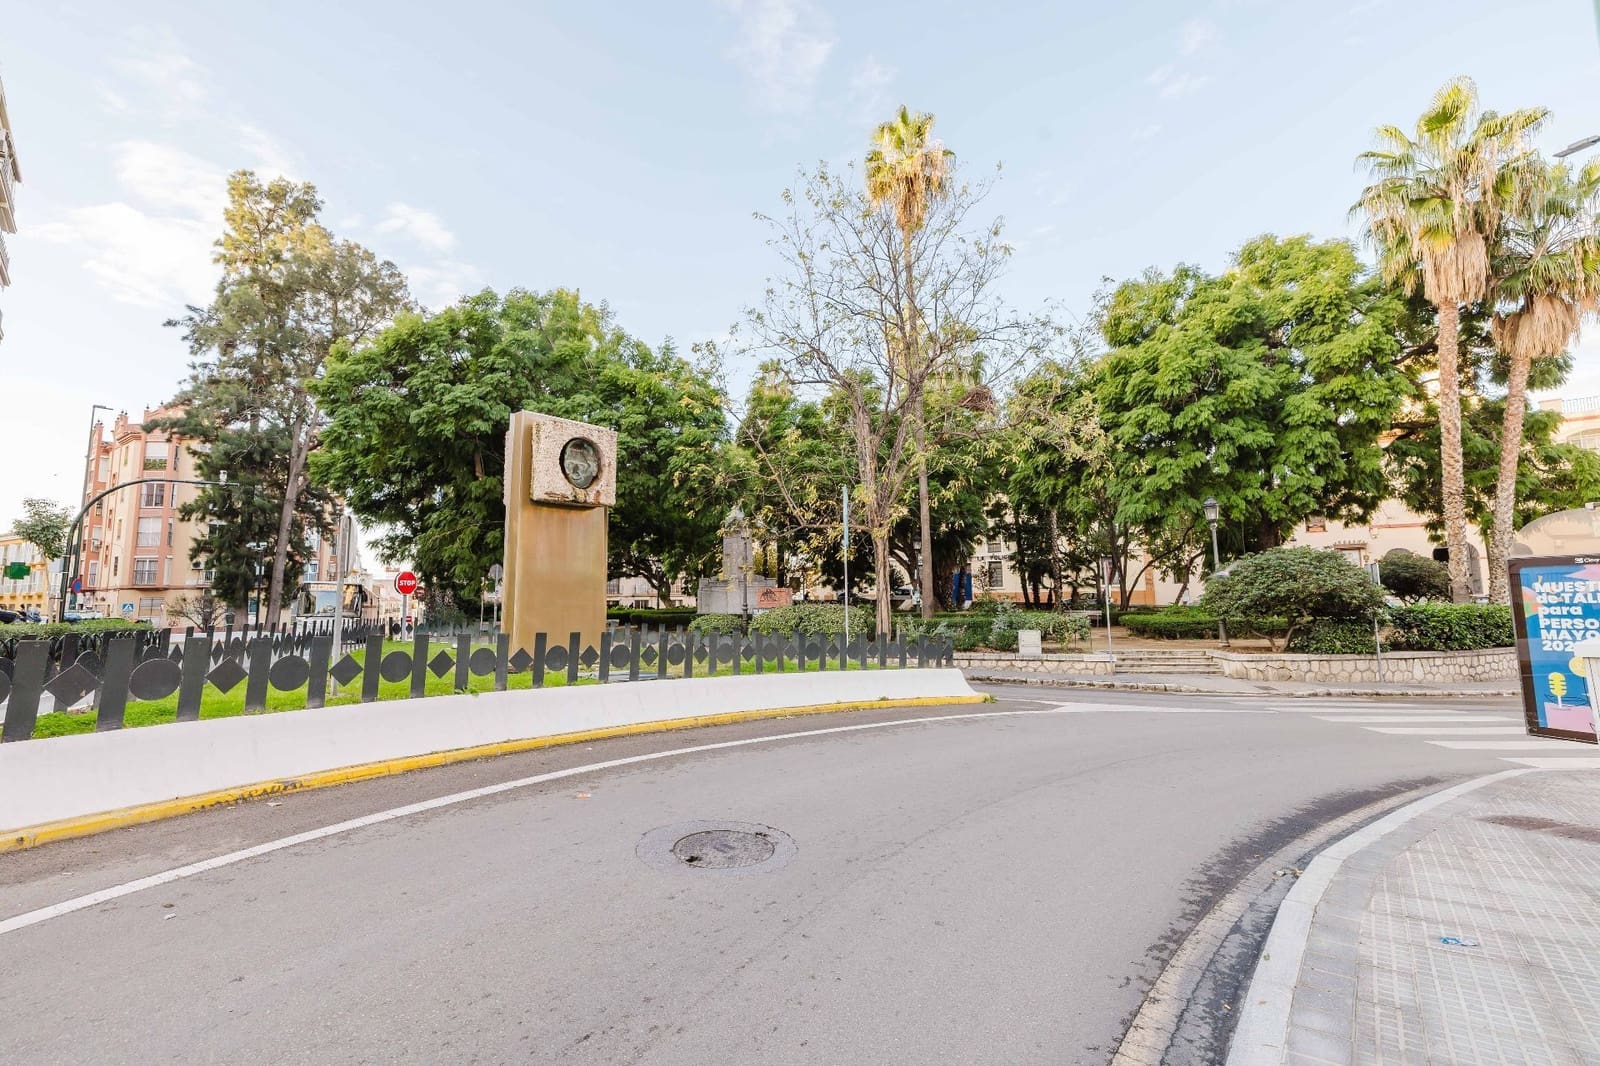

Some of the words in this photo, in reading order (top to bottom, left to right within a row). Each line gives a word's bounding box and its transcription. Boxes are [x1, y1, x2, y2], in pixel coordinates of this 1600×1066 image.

[1533, 581, 1600, 593] MUEST
[1536, 592, 1562, 604] de
[1561, 593, 1600, 604] TAL
[1538, 606, 1583, 619] para
[1539, 618, 1600, 630] PERSO
[1542, 640, 1577, 652] 202
